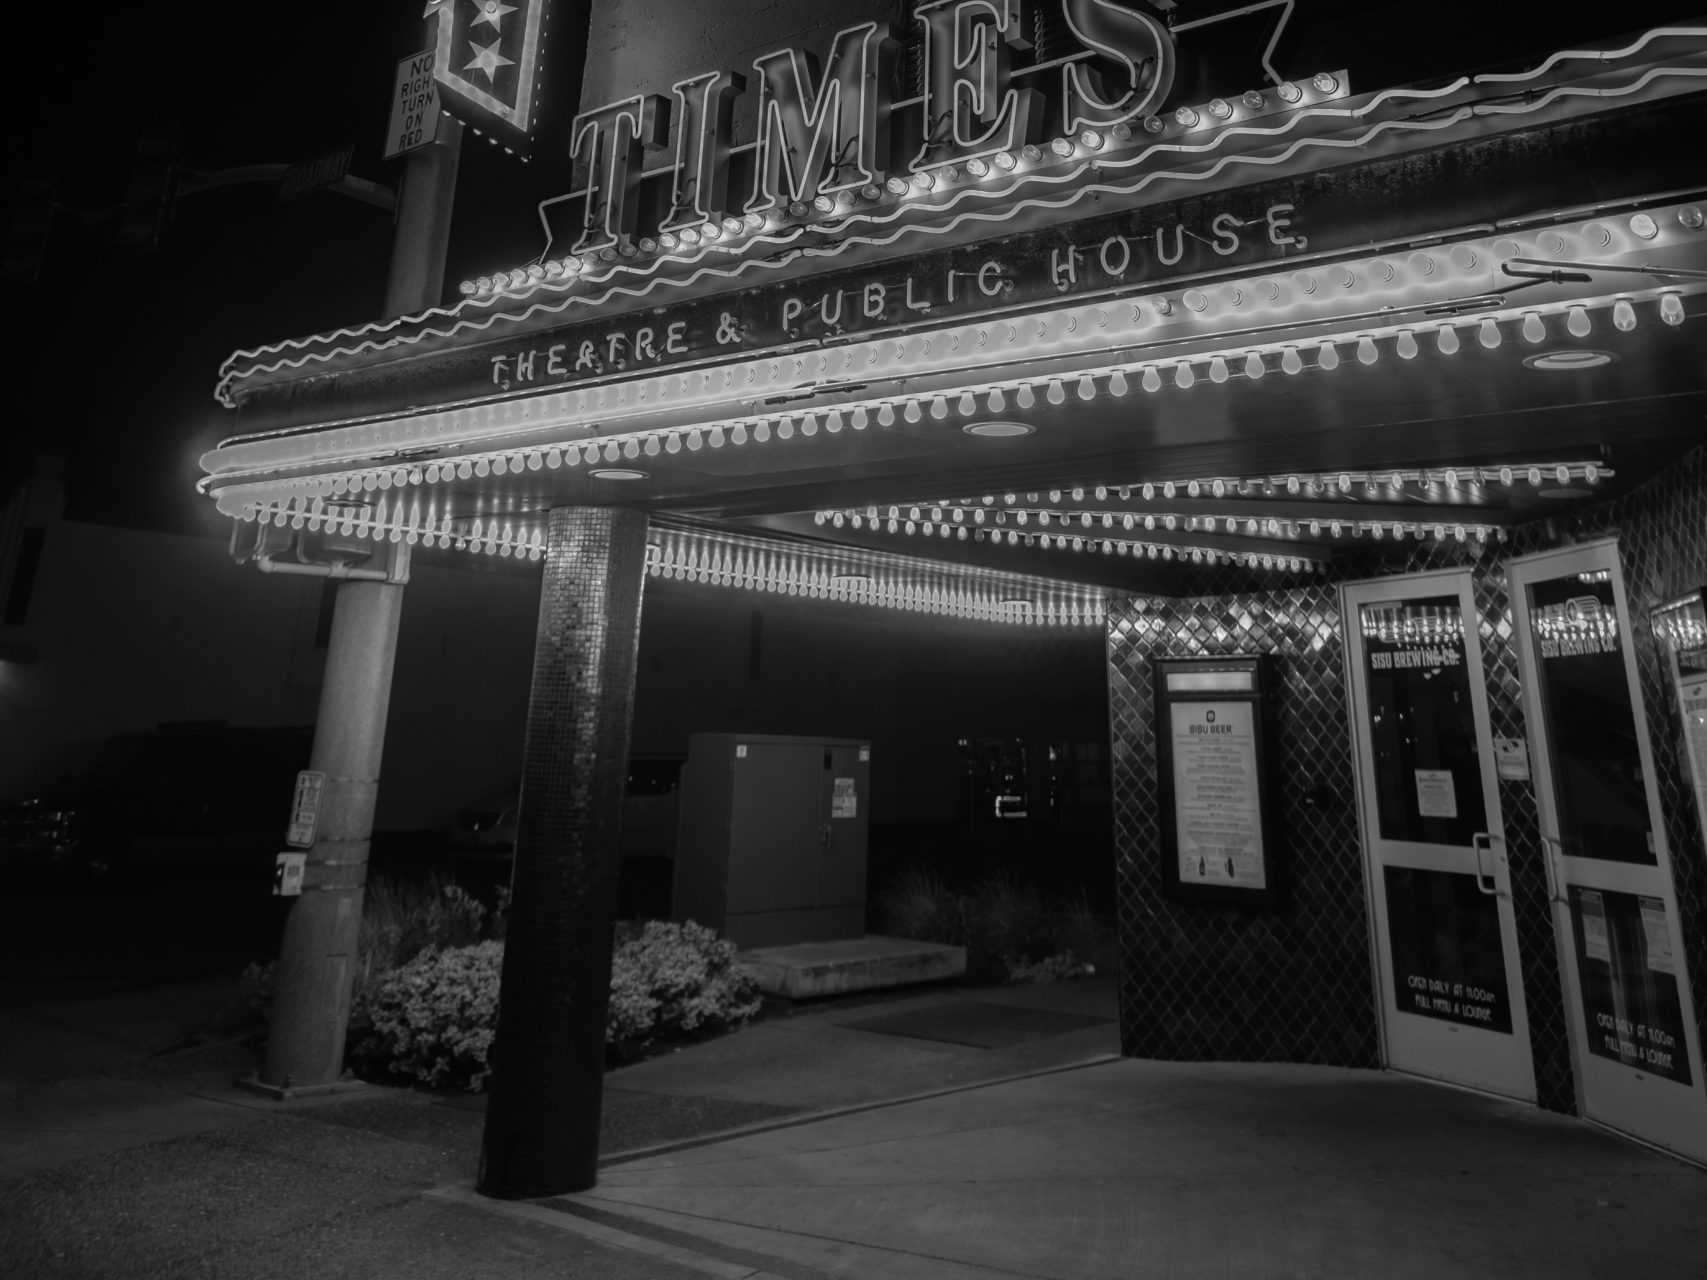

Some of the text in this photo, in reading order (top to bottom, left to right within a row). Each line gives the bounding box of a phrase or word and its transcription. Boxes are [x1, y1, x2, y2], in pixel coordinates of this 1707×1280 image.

[411, 54, 434, 78] NO
[401, 75, 436, 98] RIGH
[402, 90, 434, 115] TURN
[405, 110, 424, 131] ON
[398, 128, 423, 151] RED
[490, 203, 1299, 385] THEATRE & PUBLIC HOUSE
[1371, 651, 1393, 669] SISU
[1394, 649, 1441, 668] BREWING
